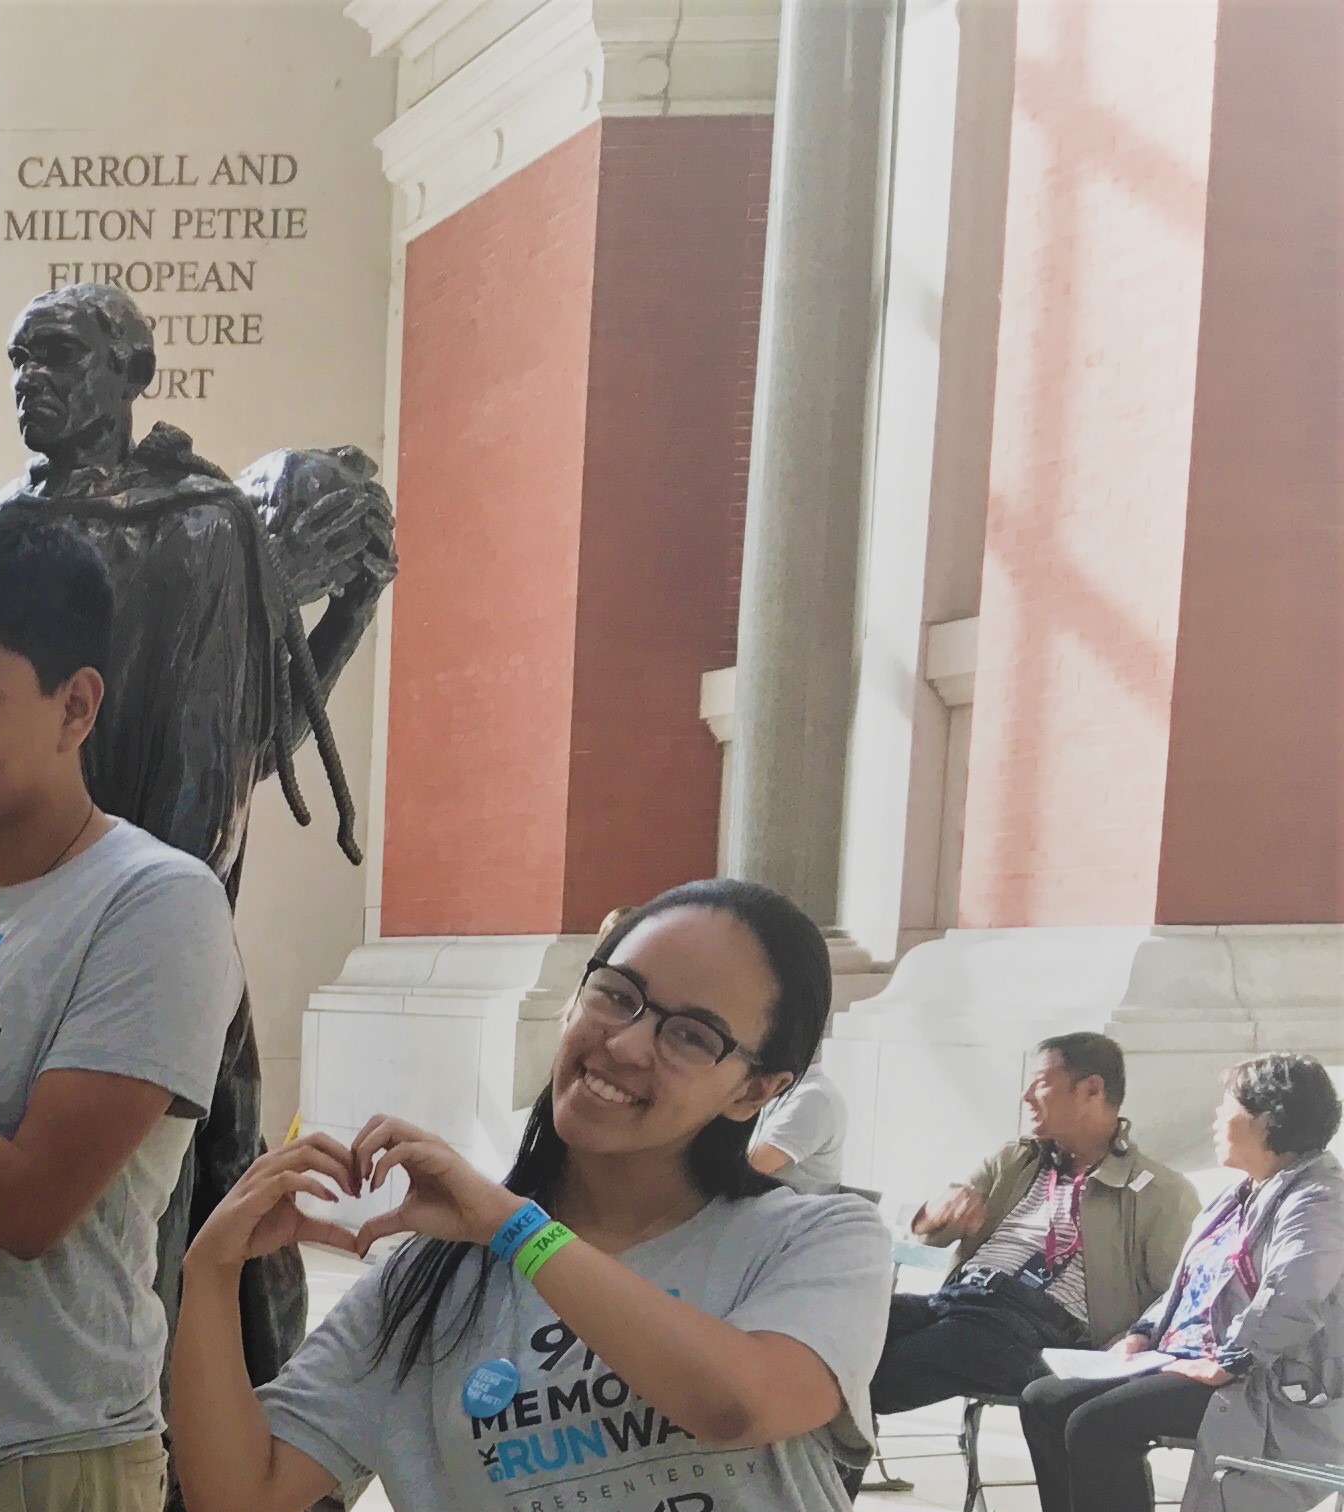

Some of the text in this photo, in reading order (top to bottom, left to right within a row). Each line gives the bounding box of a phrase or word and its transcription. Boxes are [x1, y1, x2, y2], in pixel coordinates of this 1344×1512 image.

[17, 152, 299, 188] CARROLL AND
[3, 206, 310, 242] MILTON PETRIE
[48, 259, 258, 293] EUROPEAN
[501, 1211, 536, 1244] TAKE
[533, 1225, 568, 1252] TAKE
[724, 1460, 757, 1478] BY
